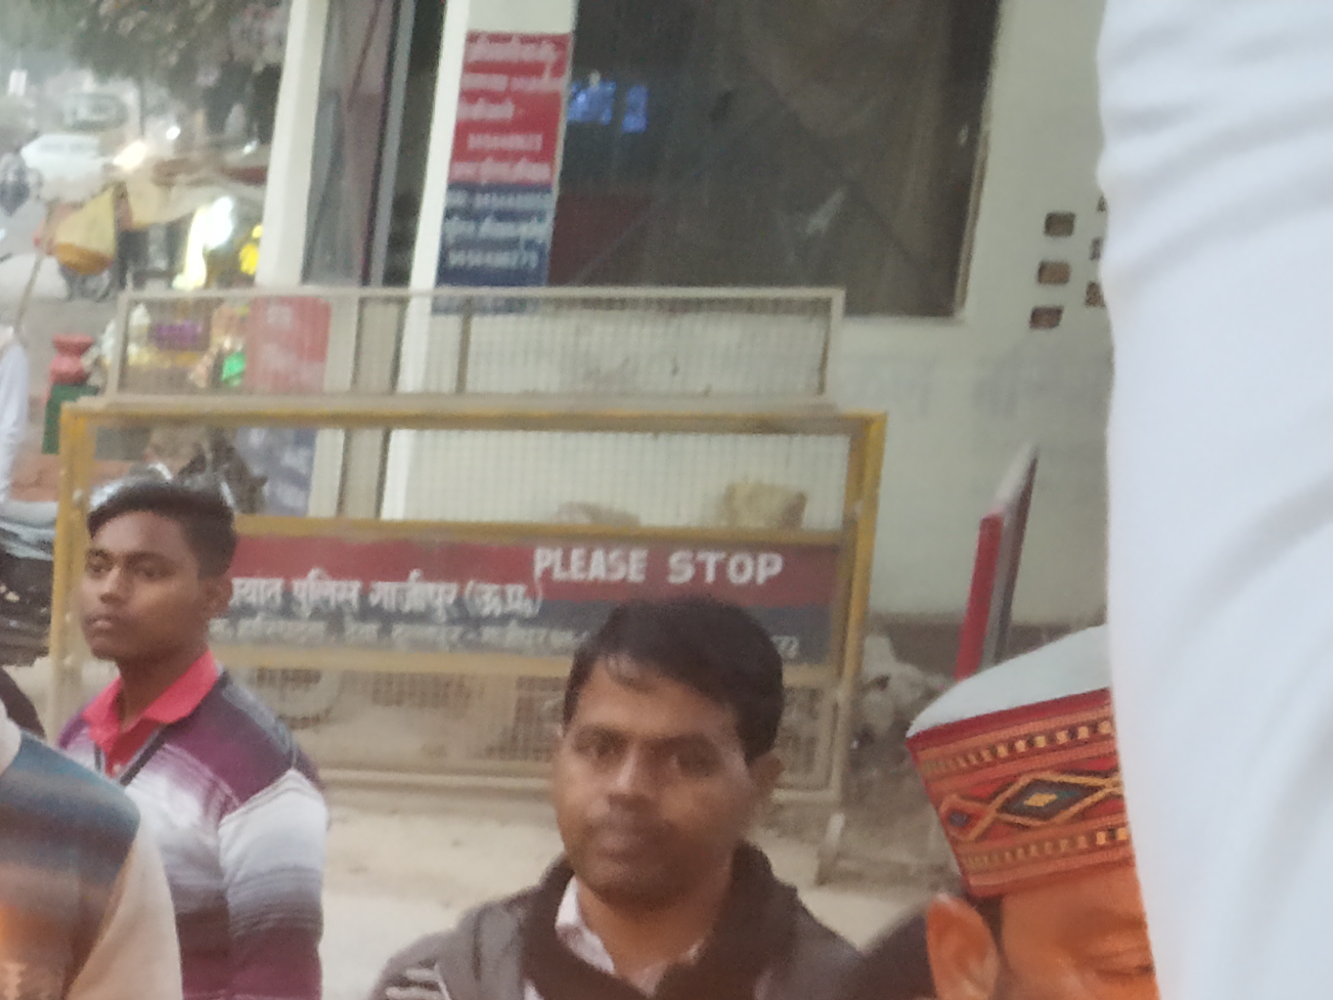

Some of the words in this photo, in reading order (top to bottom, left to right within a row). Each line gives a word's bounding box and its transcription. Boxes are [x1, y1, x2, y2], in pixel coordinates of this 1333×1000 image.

[534, 547, 649, 583] PLEASE
[666, 550, 784, 586] STOP
[291, 567, 362, 618] पुलिस
